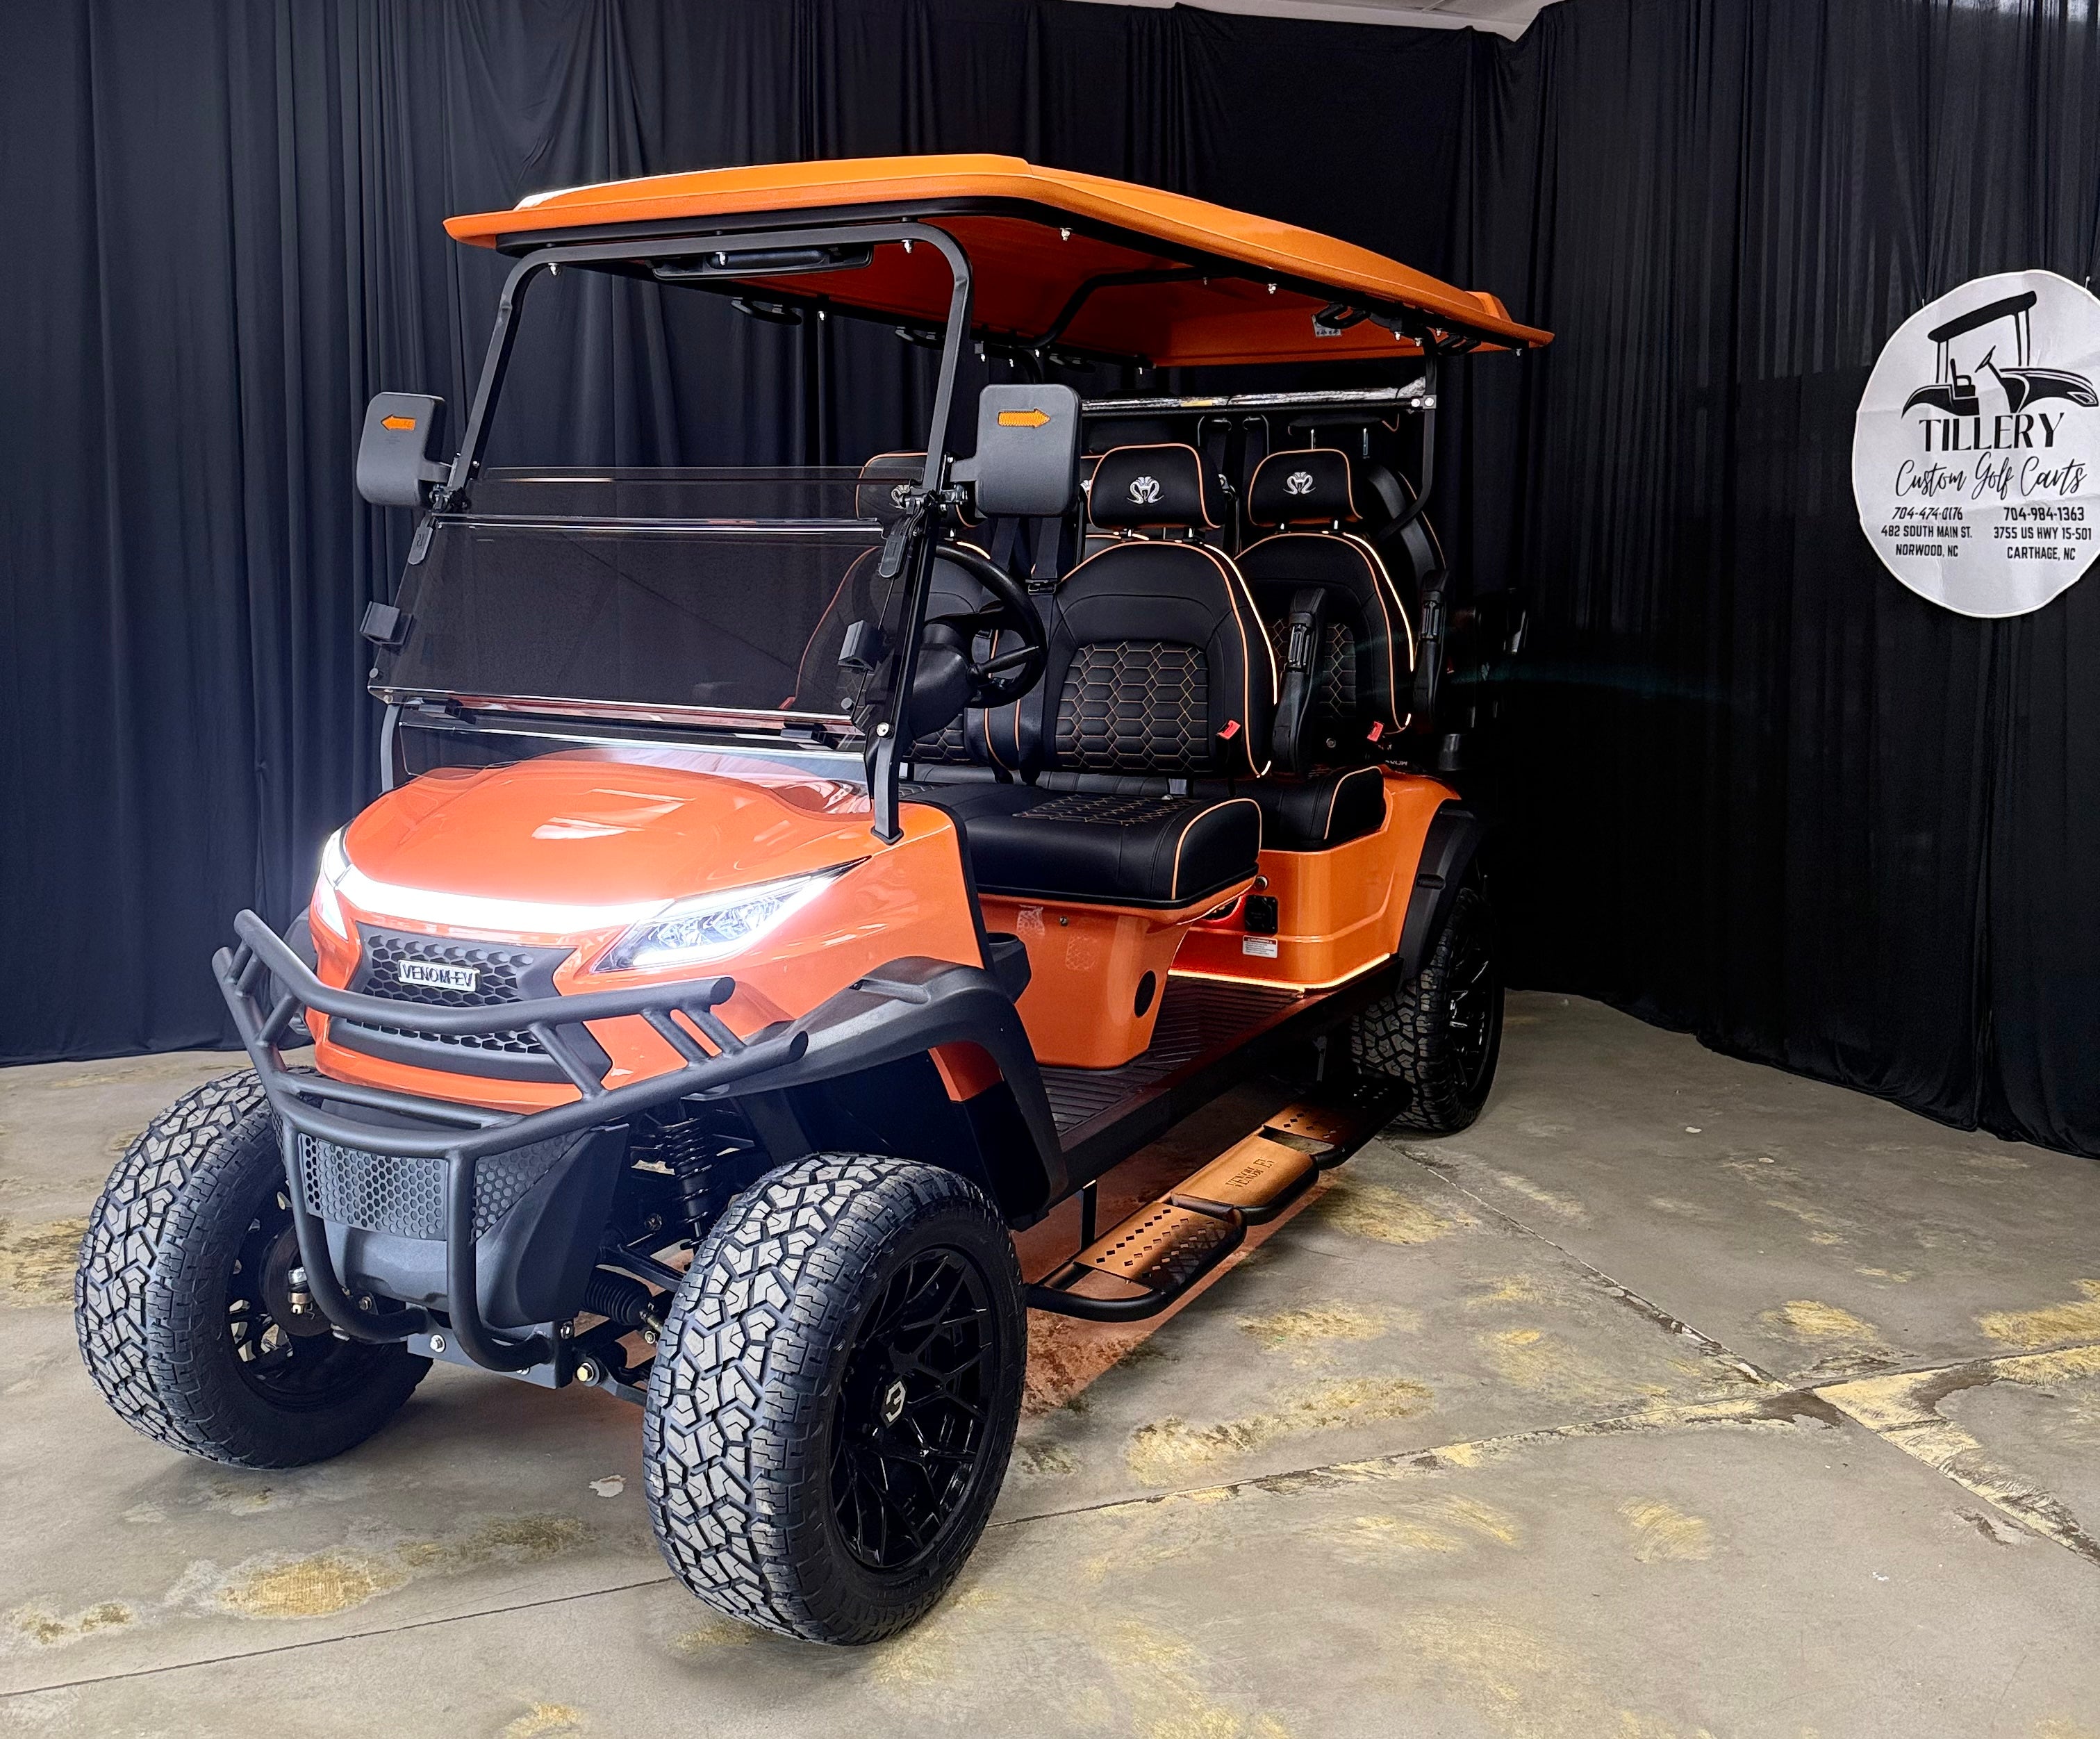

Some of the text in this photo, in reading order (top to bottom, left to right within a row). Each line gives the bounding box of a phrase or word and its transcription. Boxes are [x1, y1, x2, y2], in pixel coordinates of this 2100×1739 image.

[1919, 413, 2065, 452] TILLERY
[1895, 452, 2087, 500] Custom Golf Carts
[1892, 506, 1963, 520] 704-474-0176
[2003, 506, 2084, 521] 704-984-1363
[1881, 525, 1973, 538] 482 SOUTH MAIN ST.
[1994, 527, 2092, 541] 3755 US HWY 15-501
[1896, 543, 1958, 558] NORWOOD, NC
[2007, 547, 2076, 561] CARTHAGE, NC
[402, 964, 472, 987] VENOM-EV
